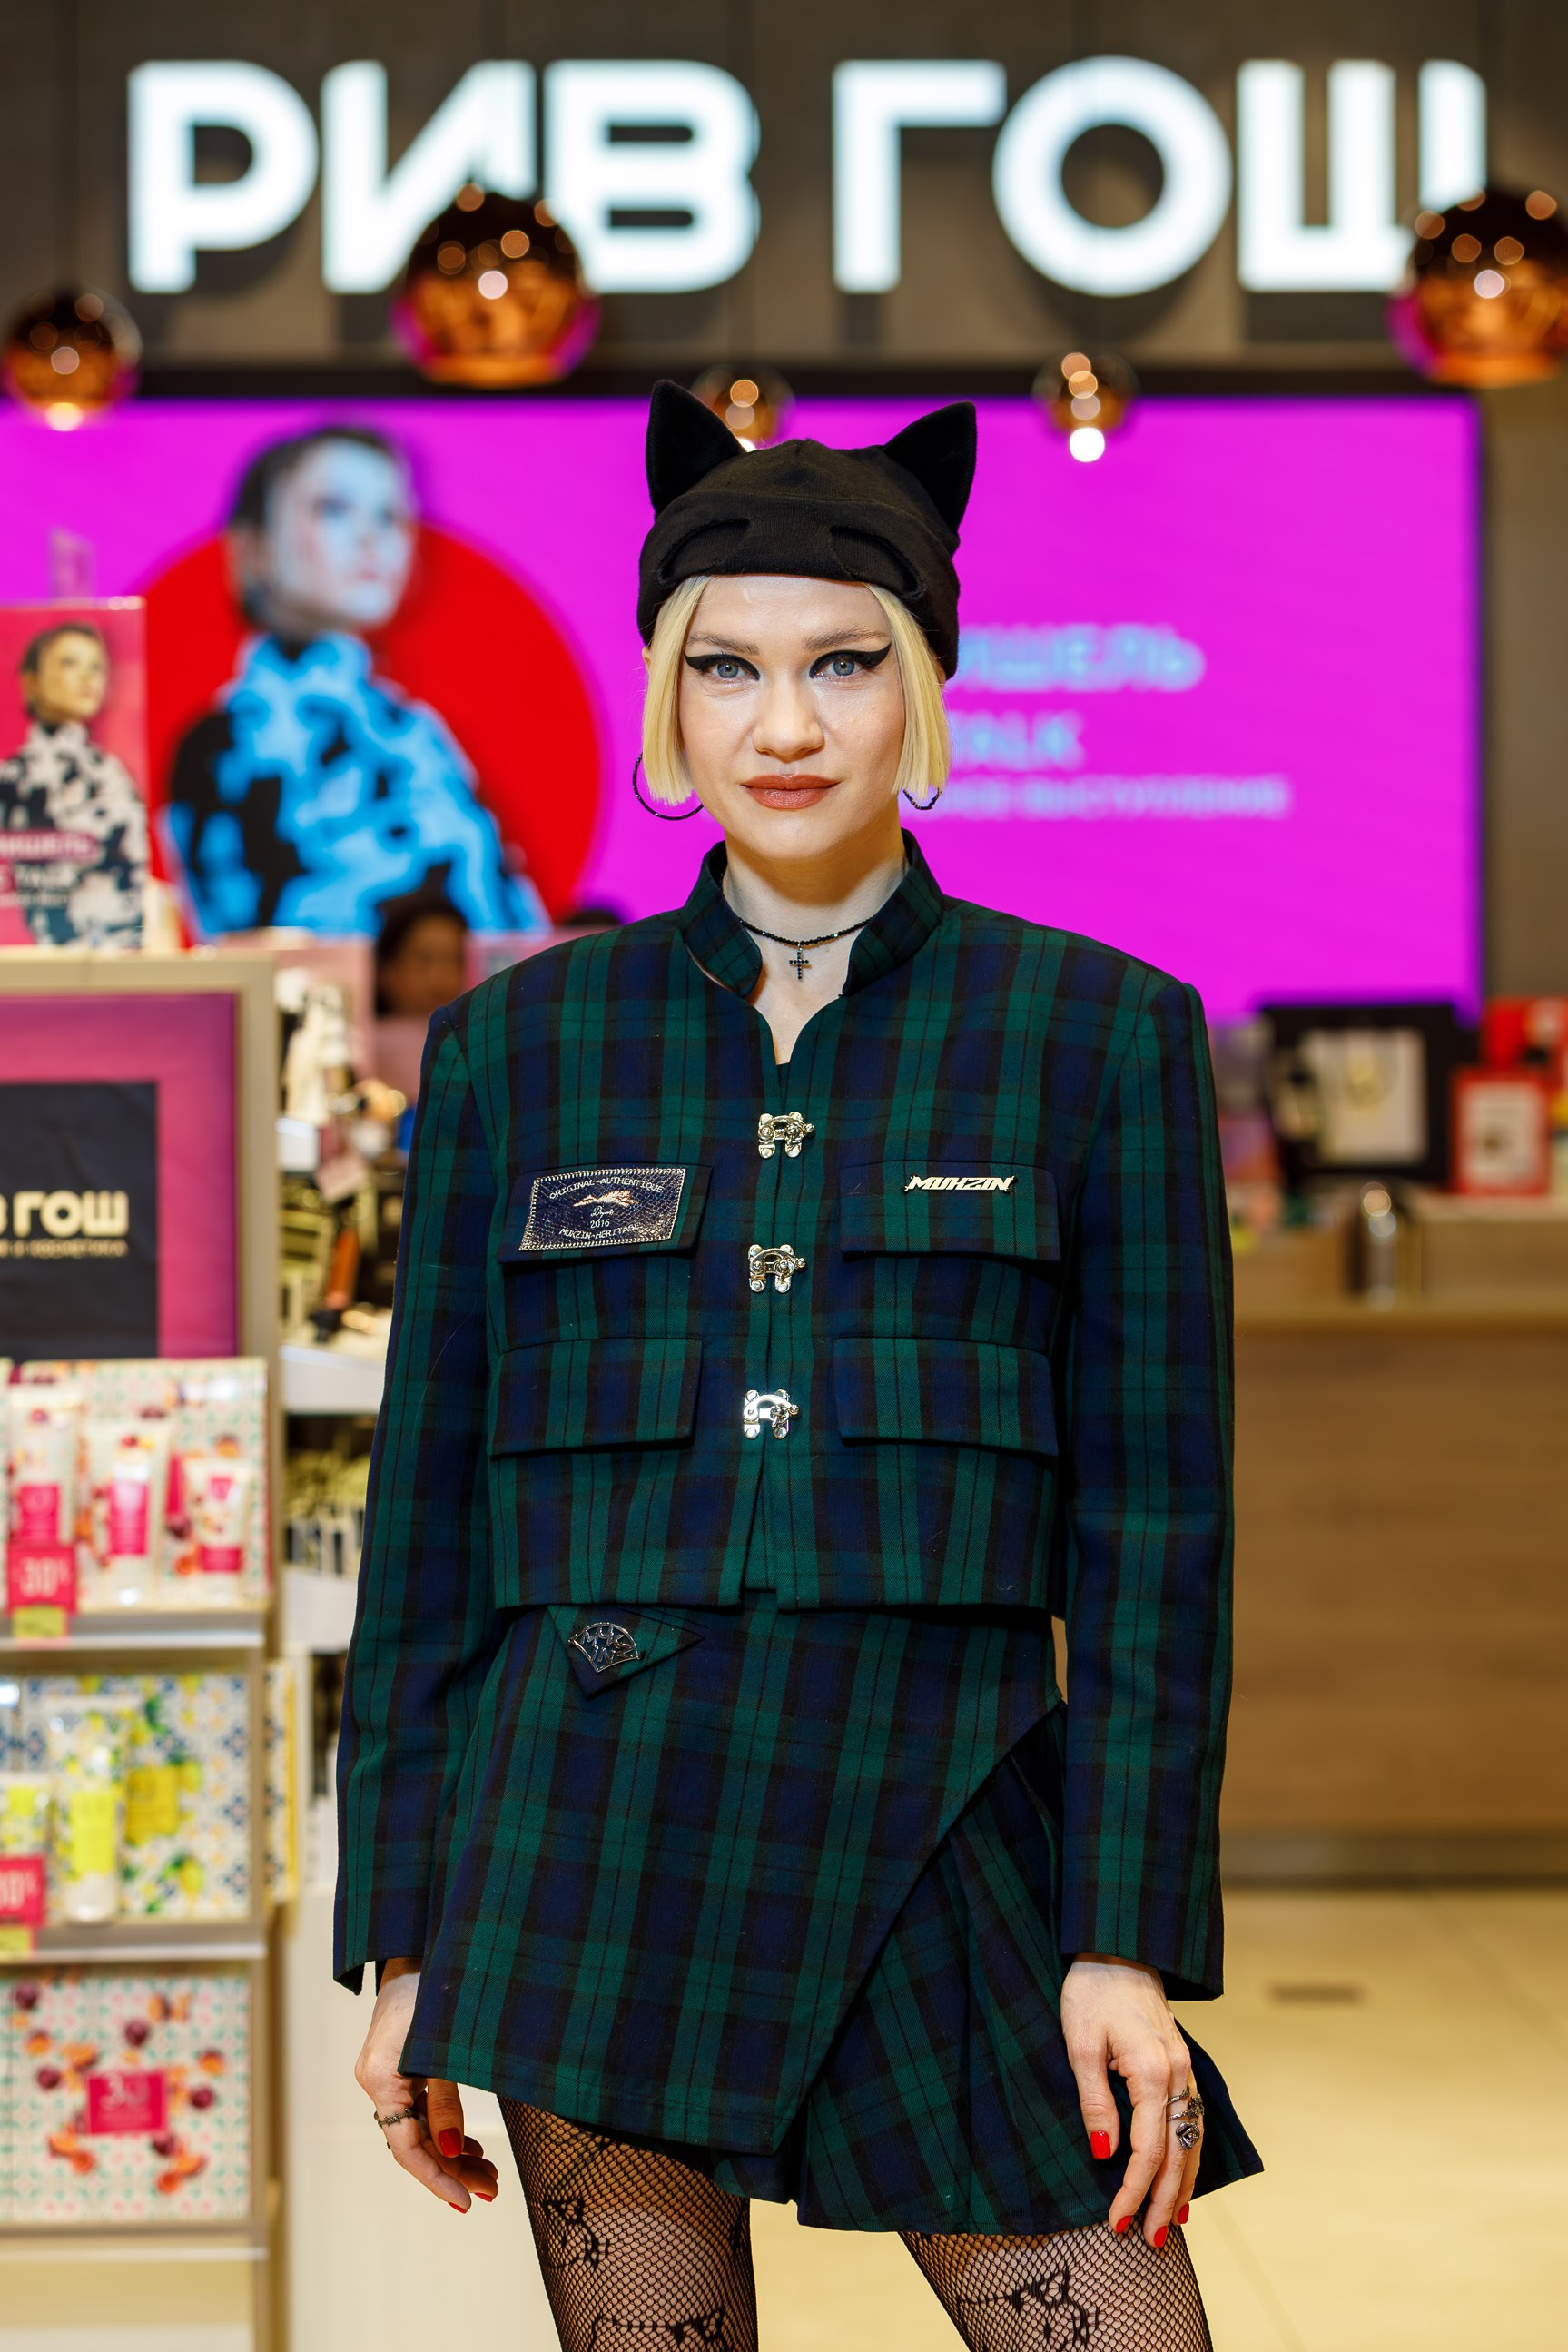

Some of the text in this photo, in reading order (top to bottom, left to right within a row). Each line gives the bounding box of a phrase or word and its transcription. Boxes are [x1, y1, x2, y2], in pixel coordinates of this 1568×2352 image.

[128, 54, 1487, 297] РИВ ГОШ
[13, 1191, 129, 1236] ГОШ
